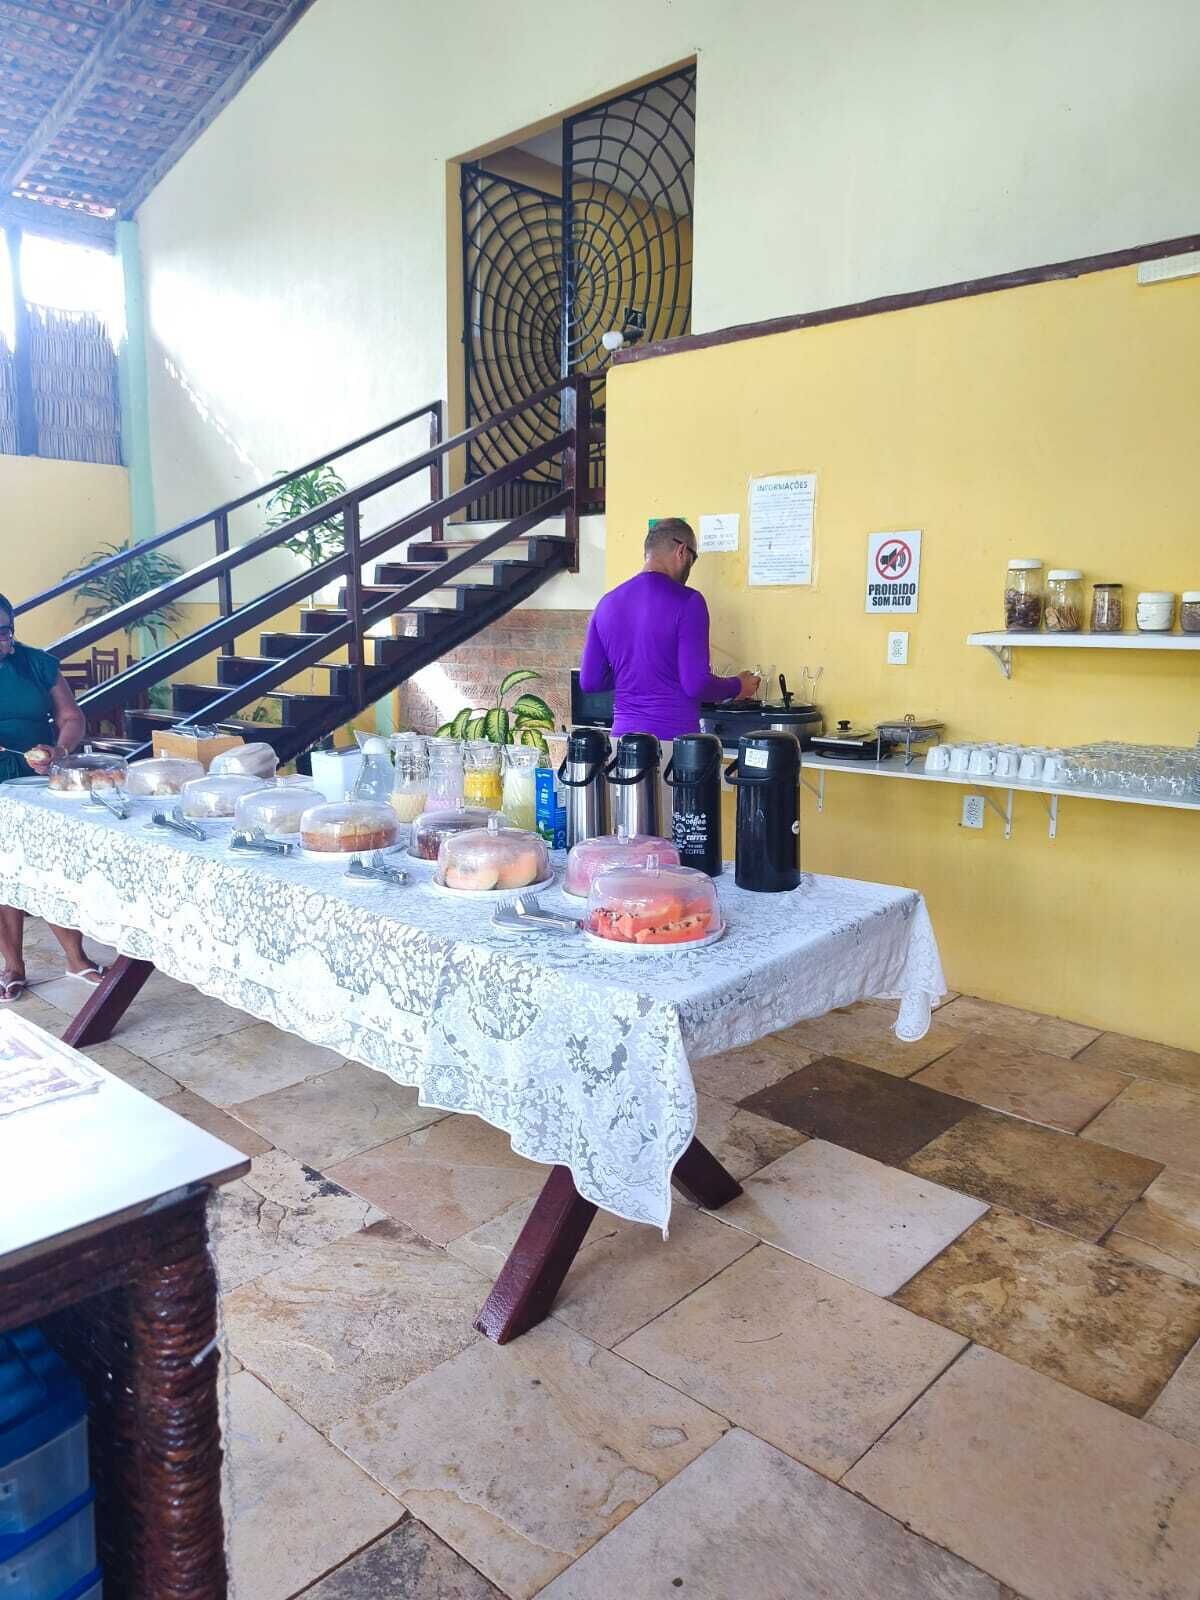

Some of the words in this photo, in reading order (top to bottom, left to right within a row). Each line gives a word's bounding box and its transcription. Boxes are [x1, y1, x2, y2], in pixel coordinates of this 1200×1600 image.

[757, 480, 809, 492] INFORMAÇÕES
[868, 583, 916, 596] PROIBIDO
[872, 596, 891, 606] SOM
[892, 596, 912, 606] ALTO
